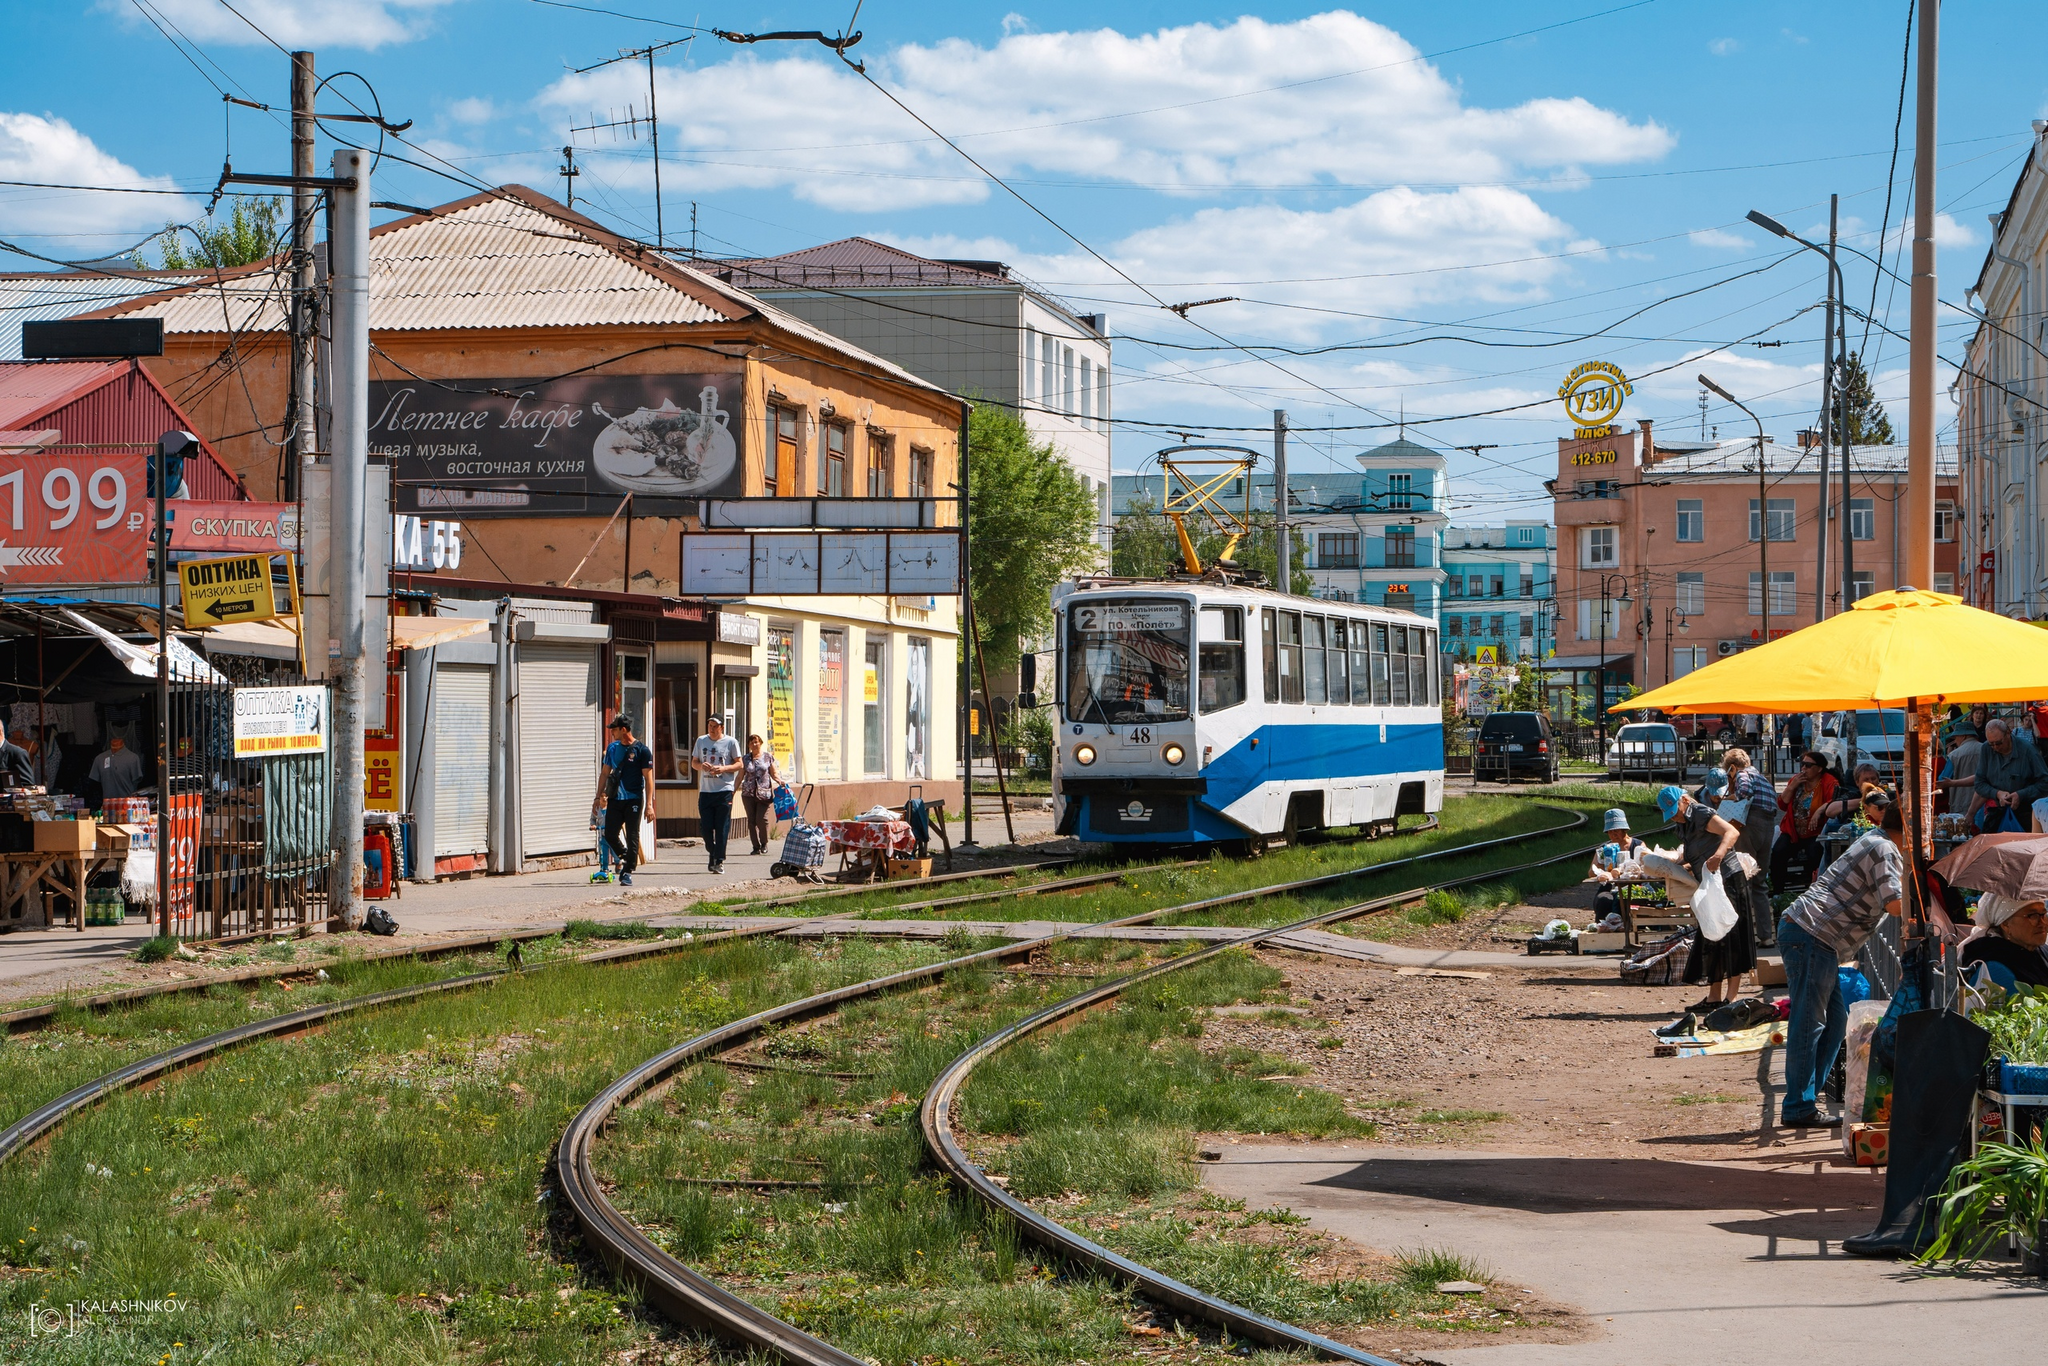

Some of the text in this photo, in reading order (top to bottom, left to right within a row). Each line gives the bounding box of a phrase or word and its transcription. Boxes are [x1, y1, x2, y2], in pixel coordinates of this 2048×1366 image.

[1573, 386, 1614, 413] УЗИ
[367, 388, 489, 432] Летнее
[415, 442, 483, 459] музыка,
[1571, 450, 1616, 466] 412-670
[447, 458, 585, 478] восточная кухня
[191, 518, 277, 538] СКУПКА
[432, 520, 461, 570] 55
[187, 558, 262, 587] ОПТИКА
[190, 582, 264, 600] НИЗКИХ ЦЕН
[1388, 584, 1398, 593] 23
[223, 604, 248, 612] МЕТРОВ
[1103, 606, 1179, 615] ул. Котельникова
[1081, 609, 1097, 630] 2
[1131, 621, 1175, 630] «Полёт»
[819, 667, 840, 691] ФОТО
[235, 691, 294, 716] ОПТИКА
[240, 738, 255, 751] ВХОД
[258, 738, 266, 749] НА
[268, 737, 286, 749] РЫНОК
[1130, 726, 1151, 743] 48
